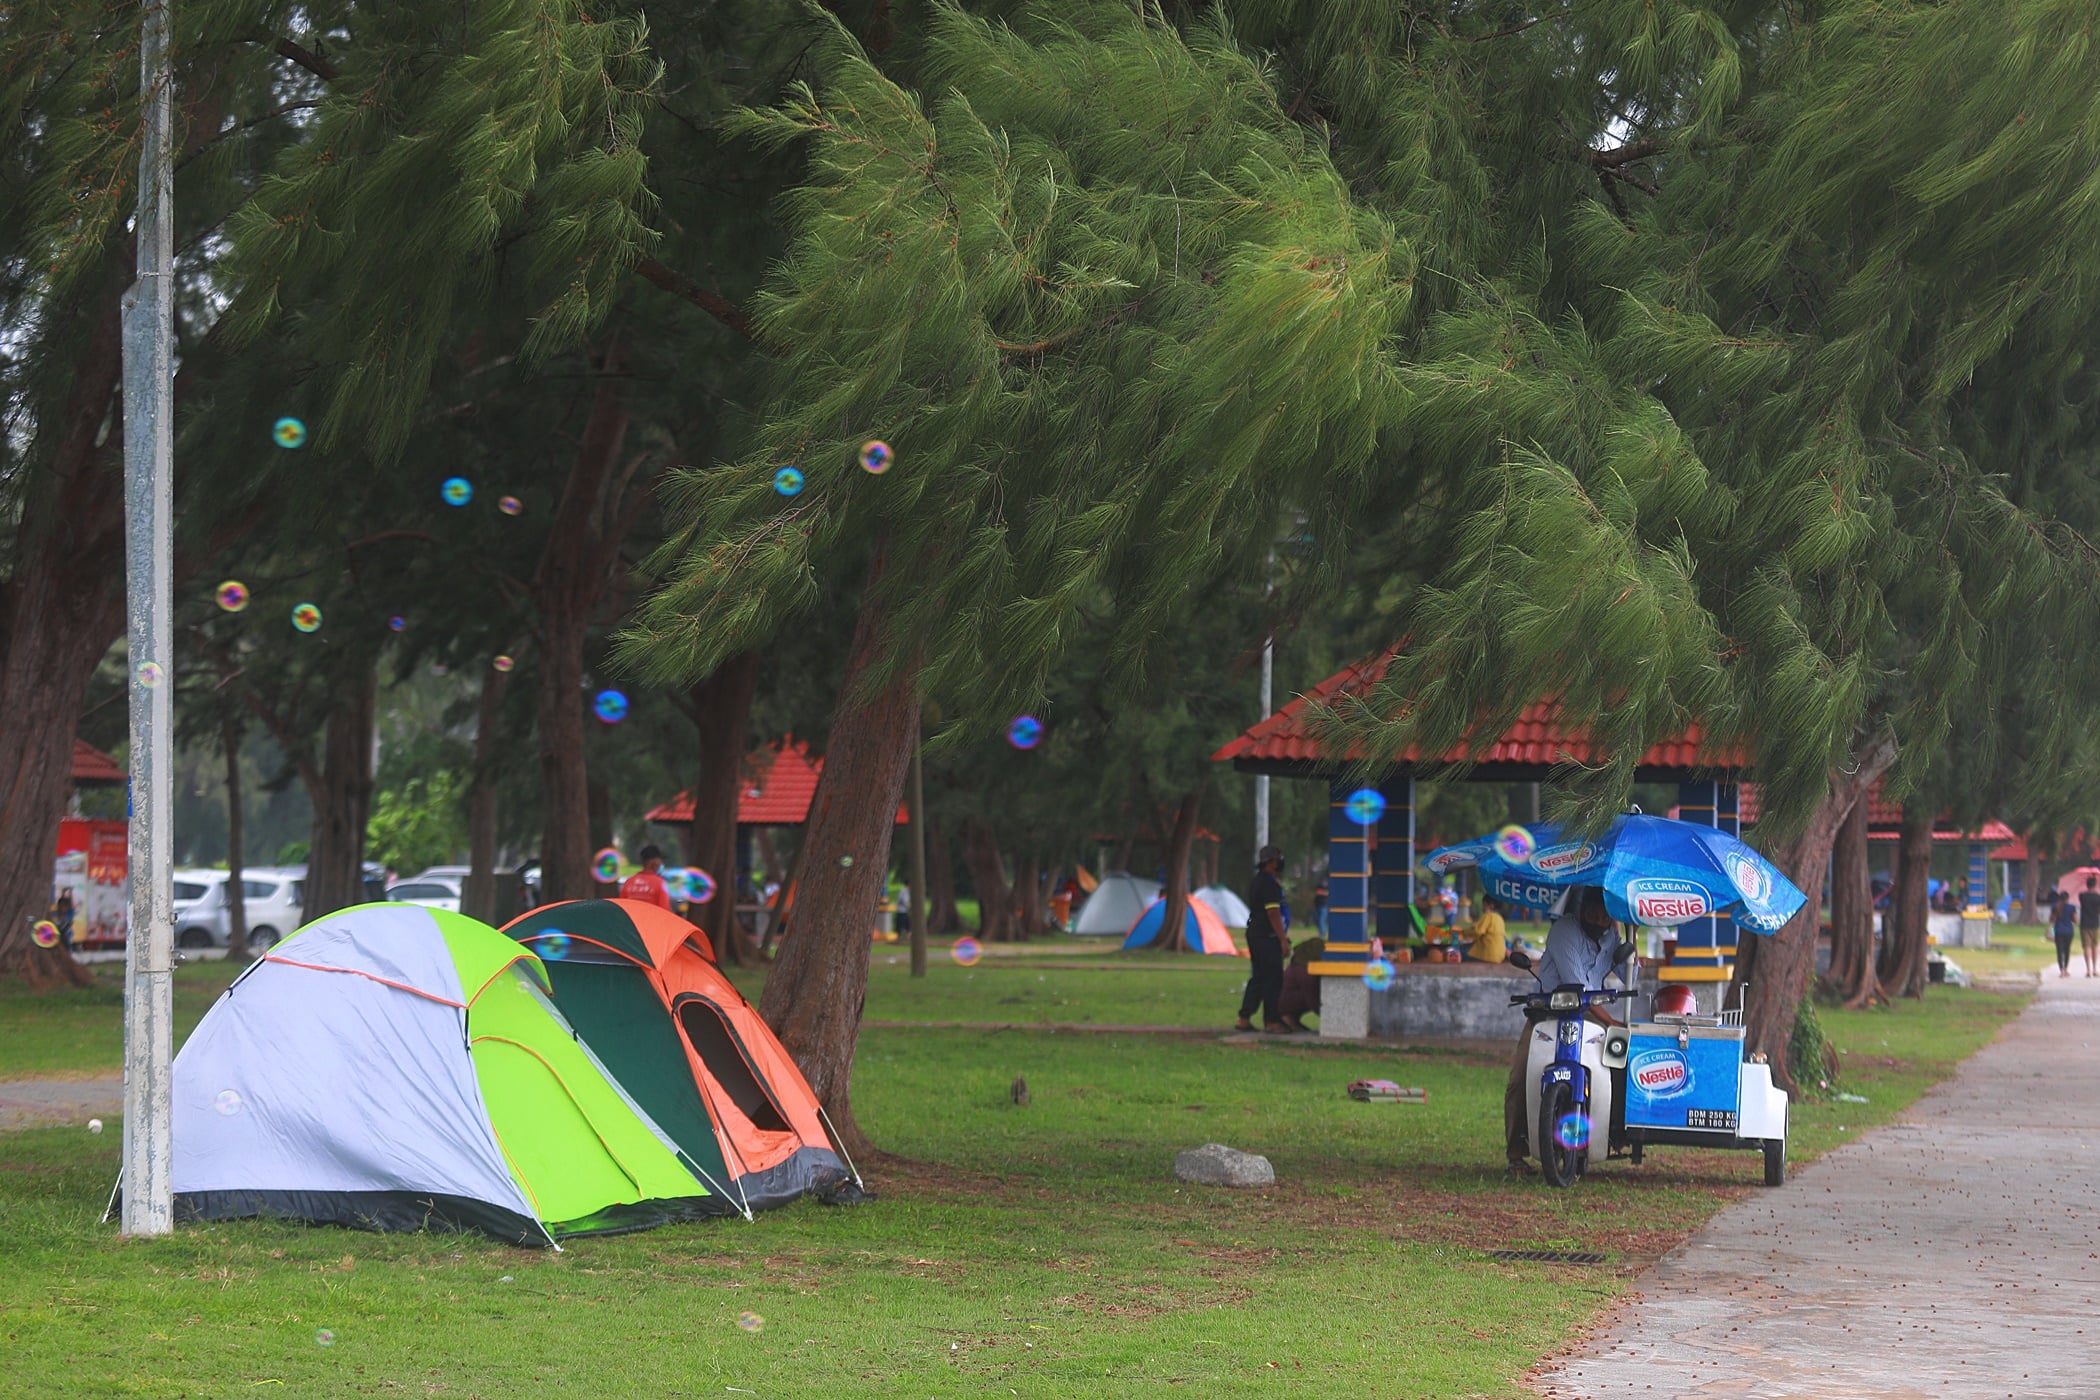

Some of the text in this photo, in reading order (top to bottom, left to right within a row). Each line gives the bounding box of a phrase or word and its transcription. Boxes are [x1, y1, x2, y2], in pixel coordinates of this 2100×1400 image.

[1495, 879, 1560, 904] ICE CRE
[1638, 882, 1692, 892] ICE CREAM
[1640, 1053, 1676, 1065] ICE CREAM
[1688, 1109, 1737, 1121] BDM 250 KG
[1688, 1118, 1705, 1127] BTM
[1725, 1120, 1736, 1128] KG
